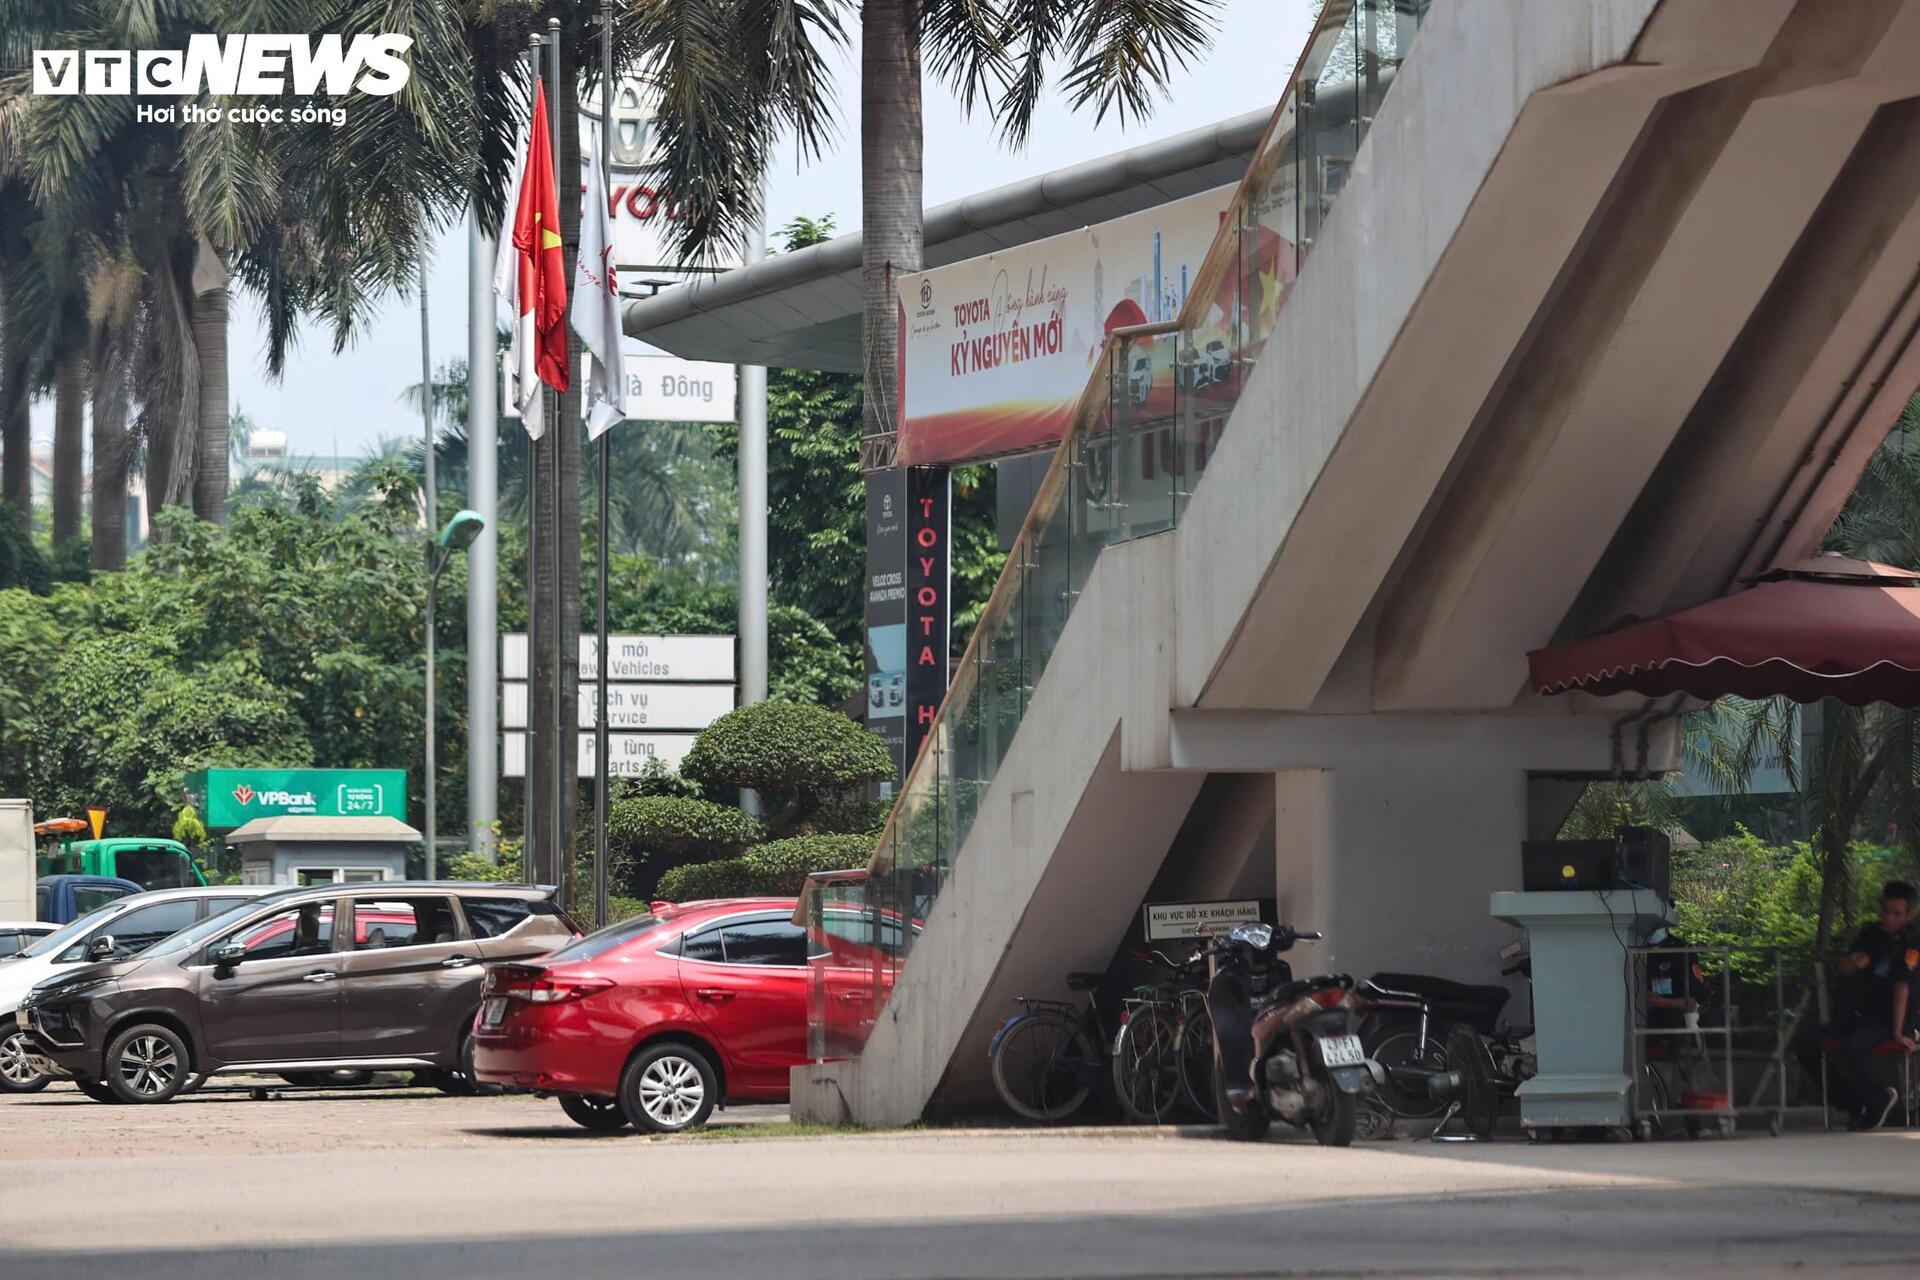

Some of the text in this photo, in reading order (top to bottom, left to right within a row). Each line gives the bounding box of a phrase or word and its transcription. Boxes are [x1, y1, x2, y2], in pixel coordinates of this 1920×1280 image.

[954, 298, 990, 328] TOYOTA
[951, 309, 1063, 376] KỶ NGUYÊN MỚI
[661, 374, 713, 402] Đông
[917, 498, 937, 665] TOYOTA
[622, 641, 648, 657] mới
[612, 661, 669, 676] Vehicles
[630, 693, 648, 709] vụ
[593, 709, 648, 724] Srvice
[624, 739, 655, 758] tùng
[608, 760, 640, 773] arts
[258, 791, 316, 805] VPBank
[347, 801, 373, 810] 24/7
[1153, 912, 1167, 920] KHU
[1199, 910, 1208, 918] XE
